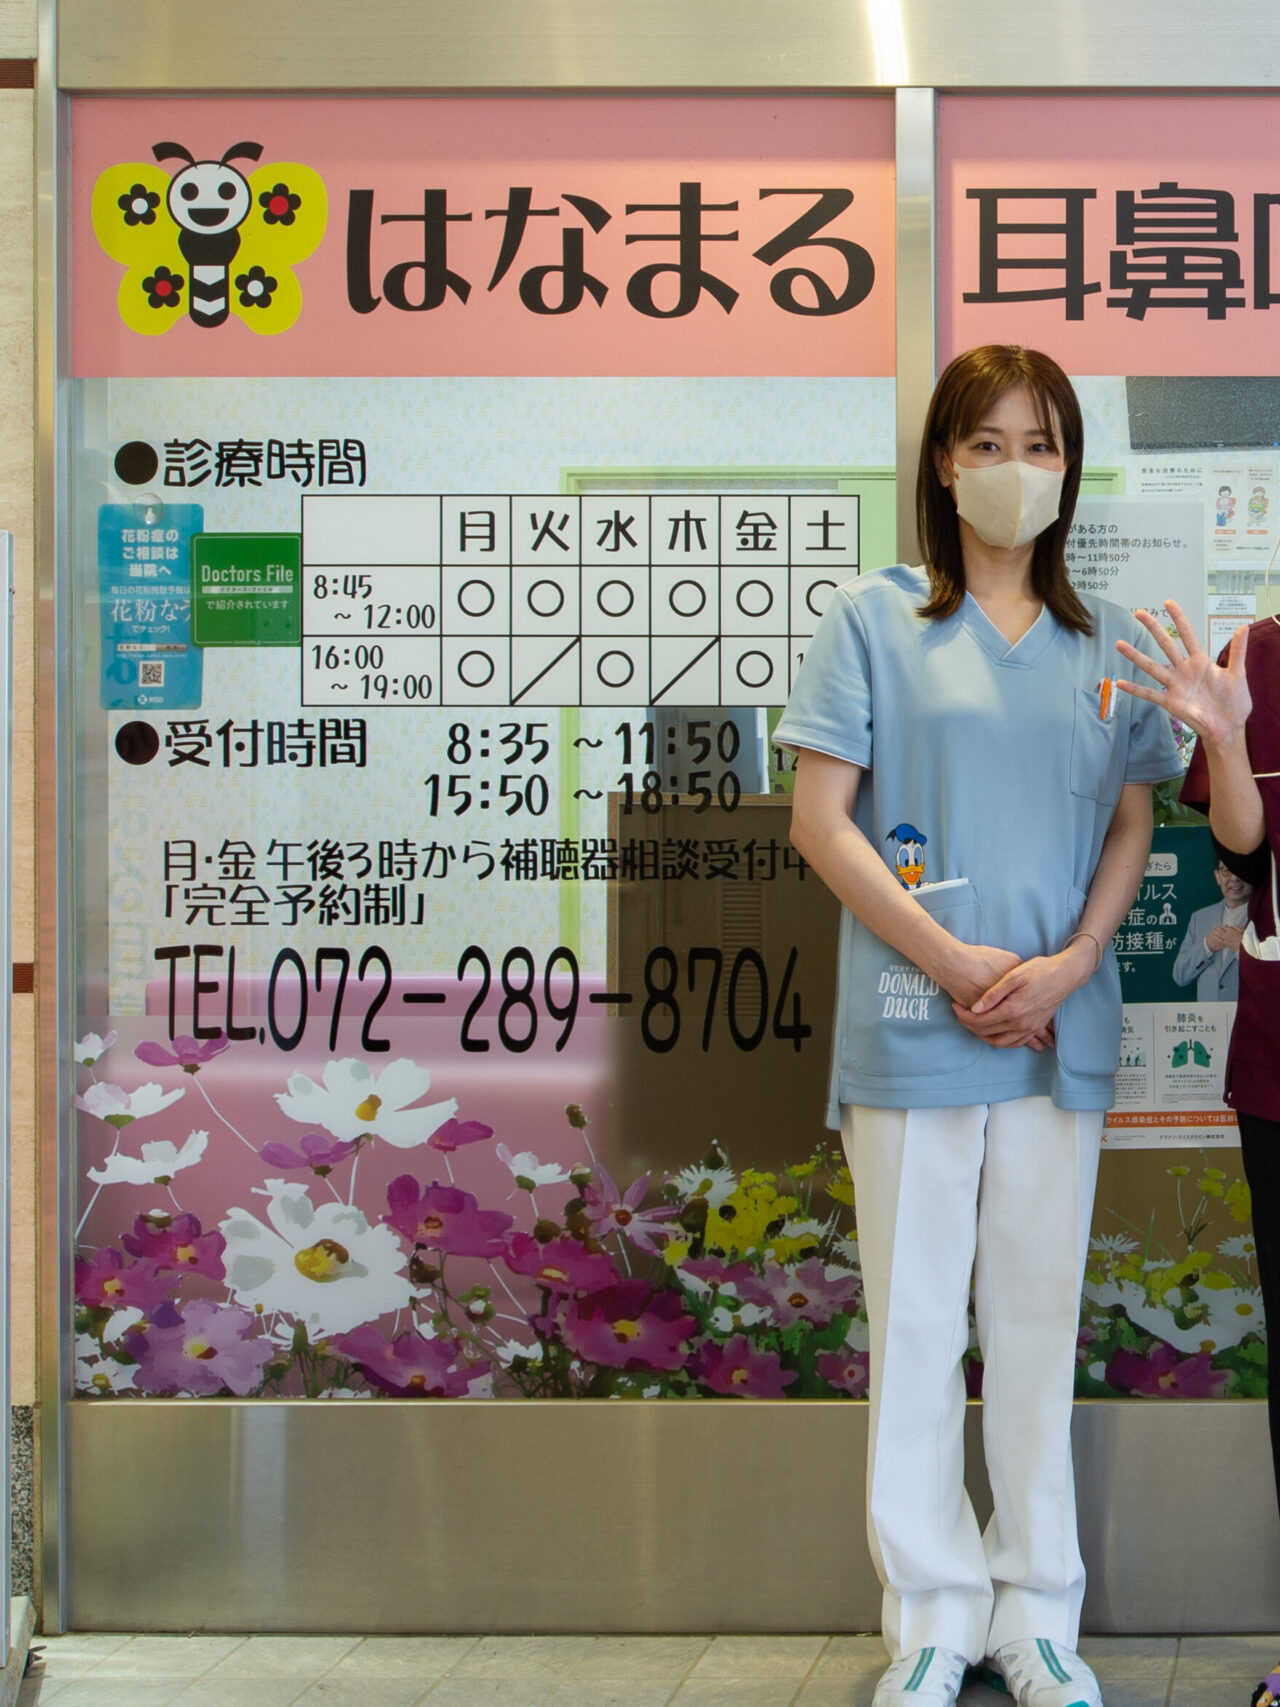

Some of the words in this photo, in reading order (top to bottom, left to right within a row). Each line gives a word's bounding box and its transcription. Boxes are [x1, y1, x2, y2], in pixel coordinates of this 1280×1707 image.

[346, 182, 876, 318] はなまる
[163, 438, 367, 487] 診療時間
[121, 529, 179, 543] 花粉症の
[459, 510, 495, 552] 月
[530, 510, 570, 552] 火
[596, 510, 638, 552] 水
[667, 510, 707, 552] 木
[735, 510, 777, 551] 金
[805, 510, 846, 550] 土
[122, 546, 179, 560] ご相談は
[129, 564, 172, 578] 当院へ
[201, 565, 261, 582] Doctors
[266, 565, 294, 582] File
[313, 575, 372, 599] 8:45
[206, 600, 289, 610] で紹介されています
[311, 645, 384, 669] 16:00
[164, 718, 367, 768] 受付時間
[447, 722, 550, 765] 8:35
[424, 773, 550, 816] 15:50
[877, 972, 939, 996] DONALD
[881, 996, 929, 1021] DUCK
[1176, 1012, 1204, 1023] 肺炎を
[1165, 1025, 1217, 1033] 引き起こすことも
